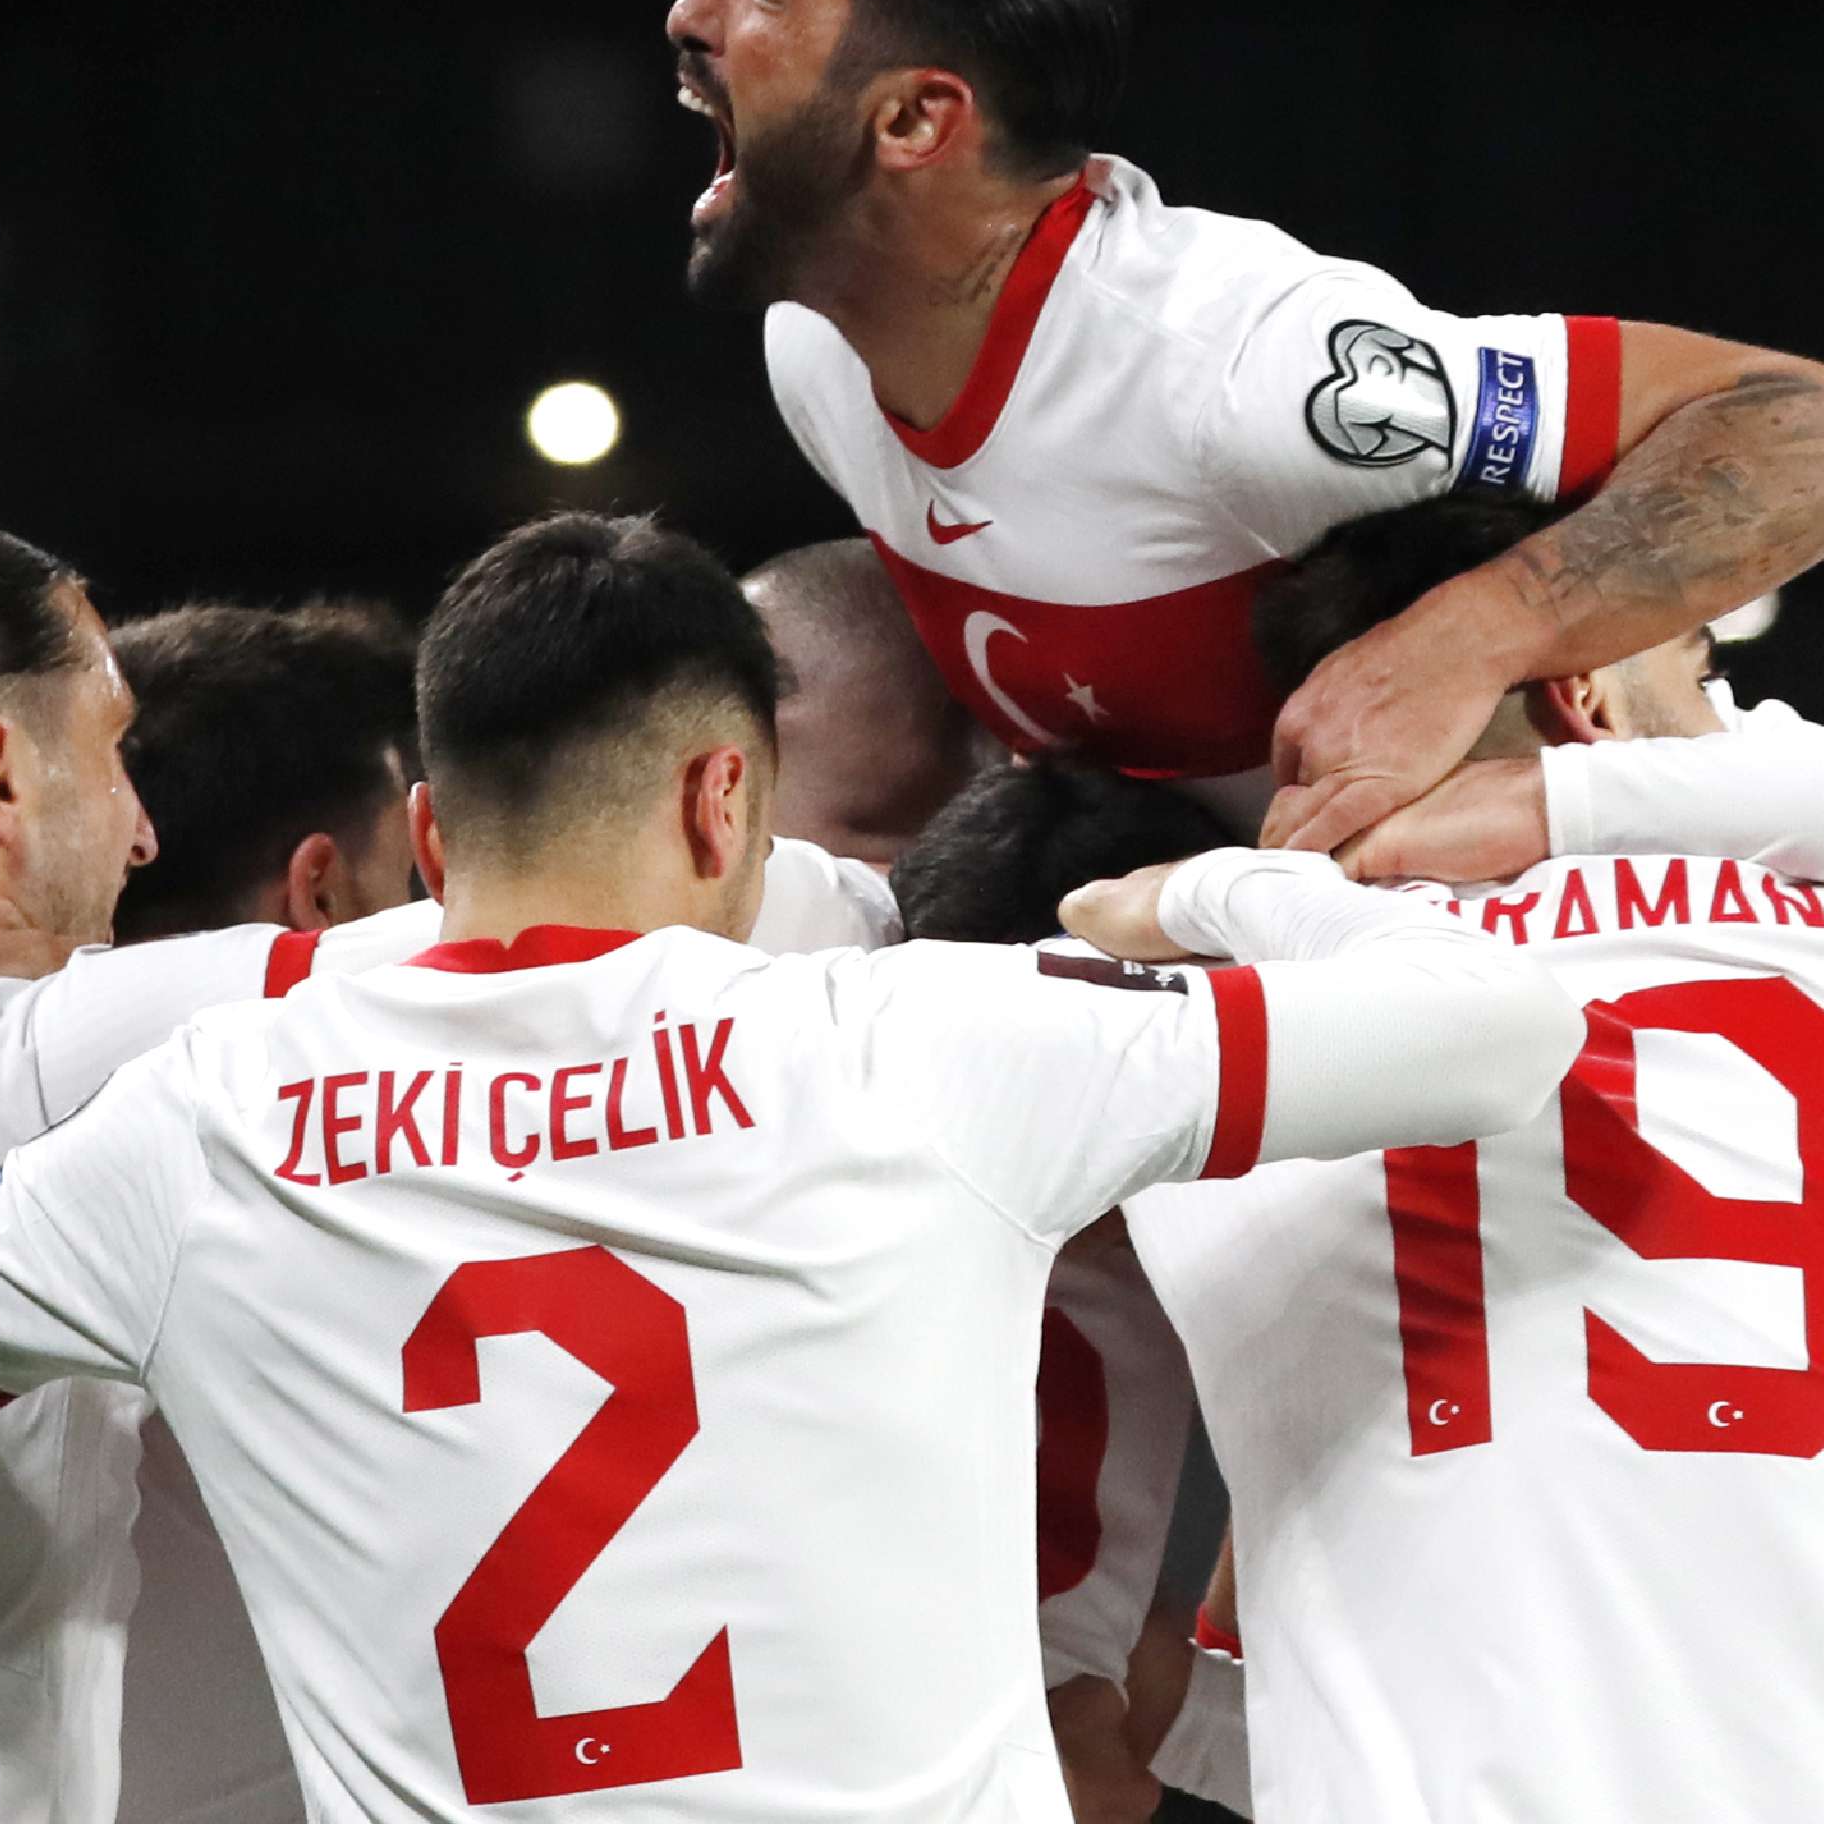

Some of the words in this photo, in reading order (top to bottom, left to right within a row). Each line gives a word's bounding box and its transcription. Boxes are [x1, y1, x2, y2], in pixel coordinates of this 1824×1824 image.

[1482, 351, 1525, 483] RESPECT
[275, 1061, 463, 1187] ZEKİ
[490, 1010, 755, 1182] ÇELİK
[402, 1245, 743, 1806] 2
